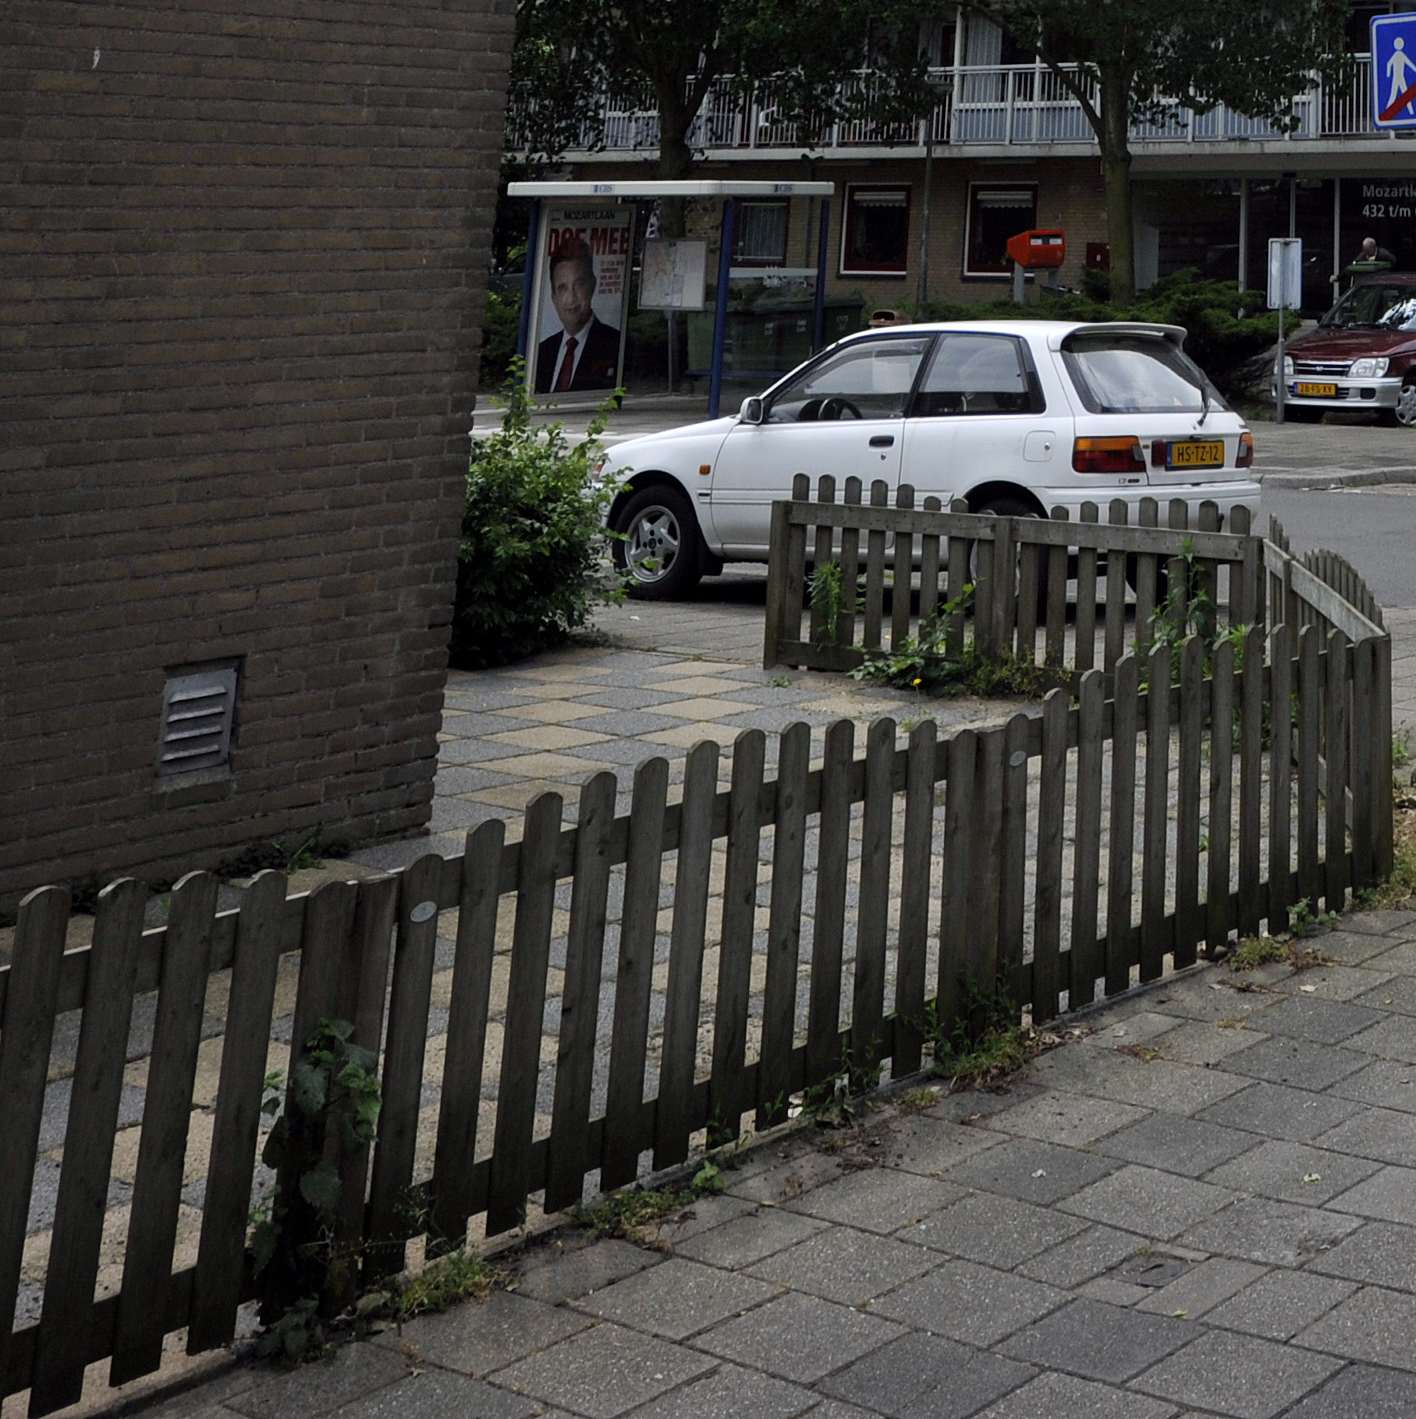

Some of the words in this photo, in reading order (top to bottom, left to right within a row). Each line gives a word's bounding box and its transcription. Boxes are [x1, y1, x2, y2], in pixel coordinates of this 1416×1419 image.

[564, 210, 615, 220] MOZARTLAAN
[1362, 203, 1385, 218] 432
[1388, 203, 1411, 218] t/m
